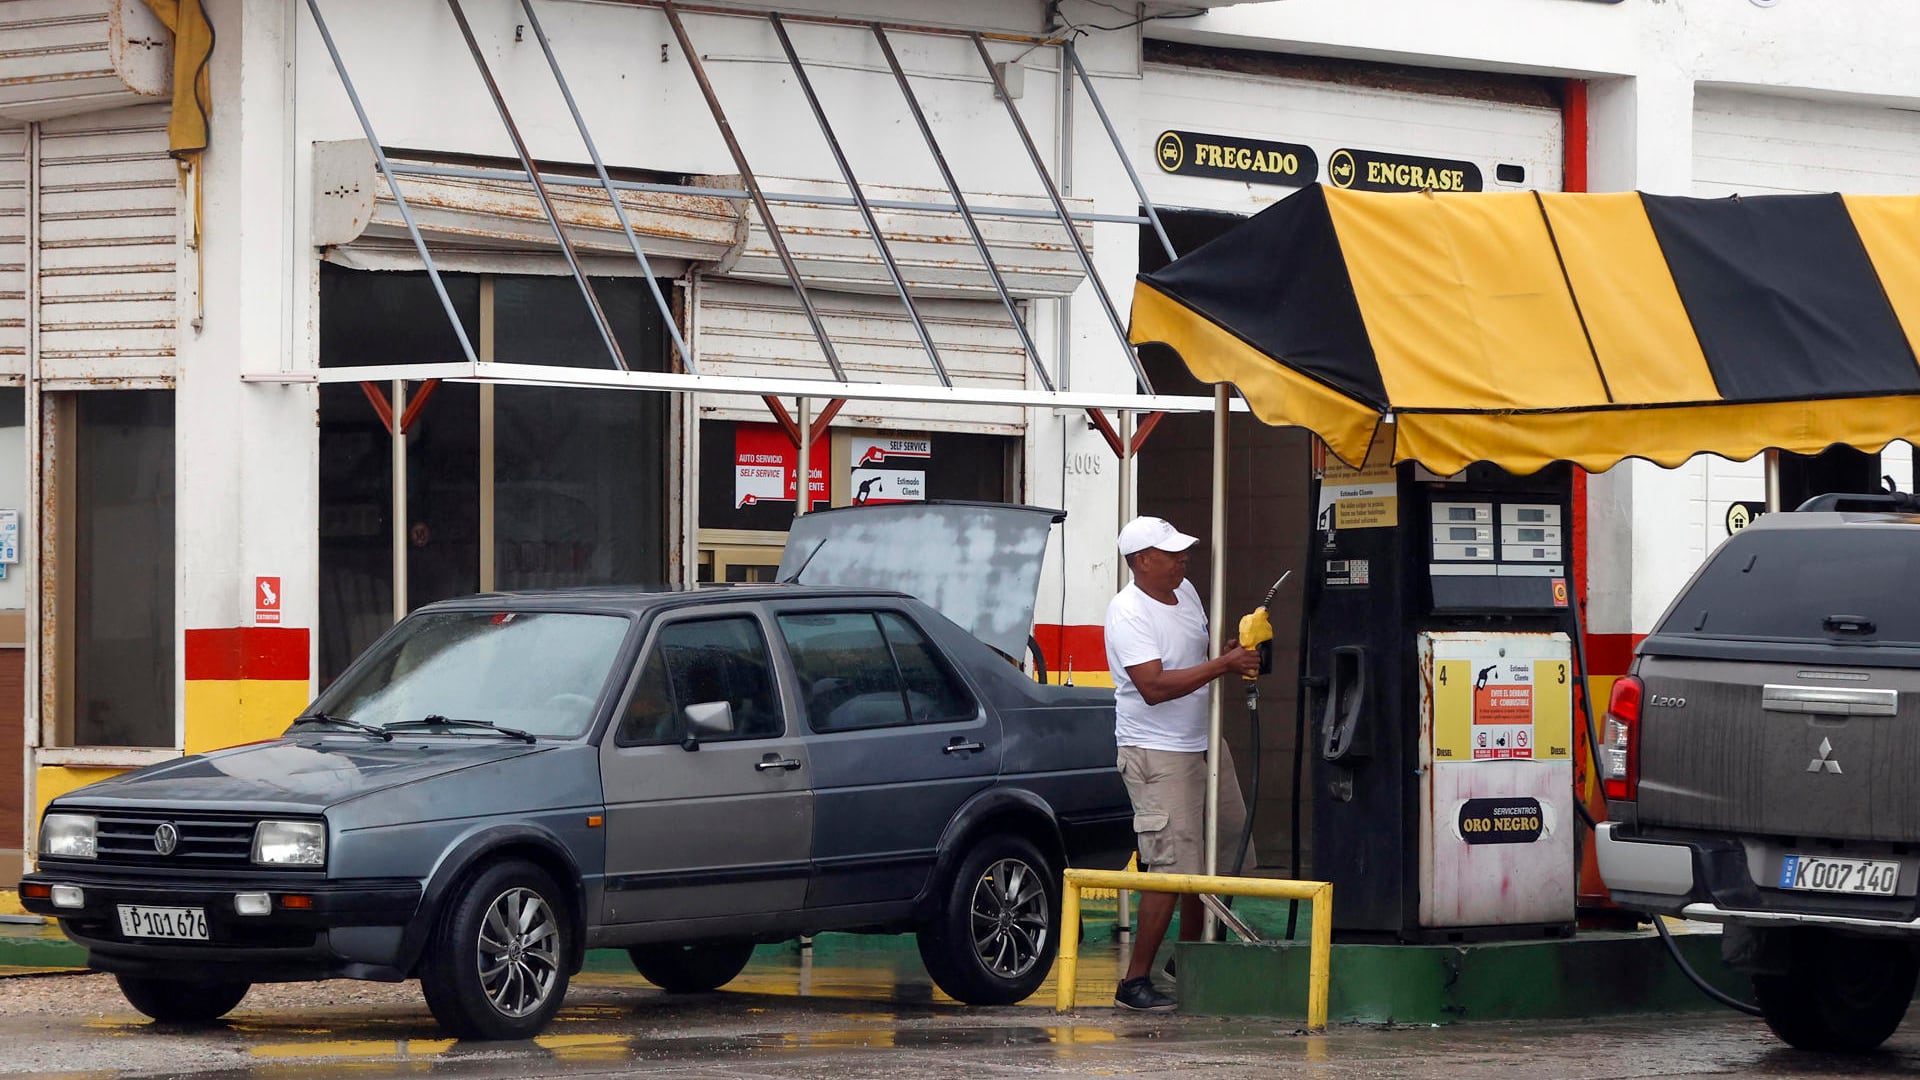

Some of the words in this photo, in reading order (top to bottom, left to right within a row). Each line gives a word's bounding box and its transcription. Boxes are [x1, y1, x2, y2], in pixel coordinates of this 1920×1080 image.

[1194, 142, 1299, 176] FREGADO
[1366, 160, 1465, 192] ENGRASE
[889, 440, 903, 451] SELF
[903, 442, 927, 452] SERVICE
[738, 453, 755, 464] AUTO
[755, 455, 783, 464] SERVICIO
[740, 467, 755, 478] SELF
[755, 468, 781, 478] SERVICE
[896, 476, 920, 486] Estimado
[1439, 665, 1448, 687] 4
[1557, 663, 1566, 685] 3
[1650, 694, 1687, 708] L200
[1492, 806, 1537, 815] SERVICENTROS
[1463, 818, 1491, 832] ORO
[1494, 816, 1539, 831] NEGRO
